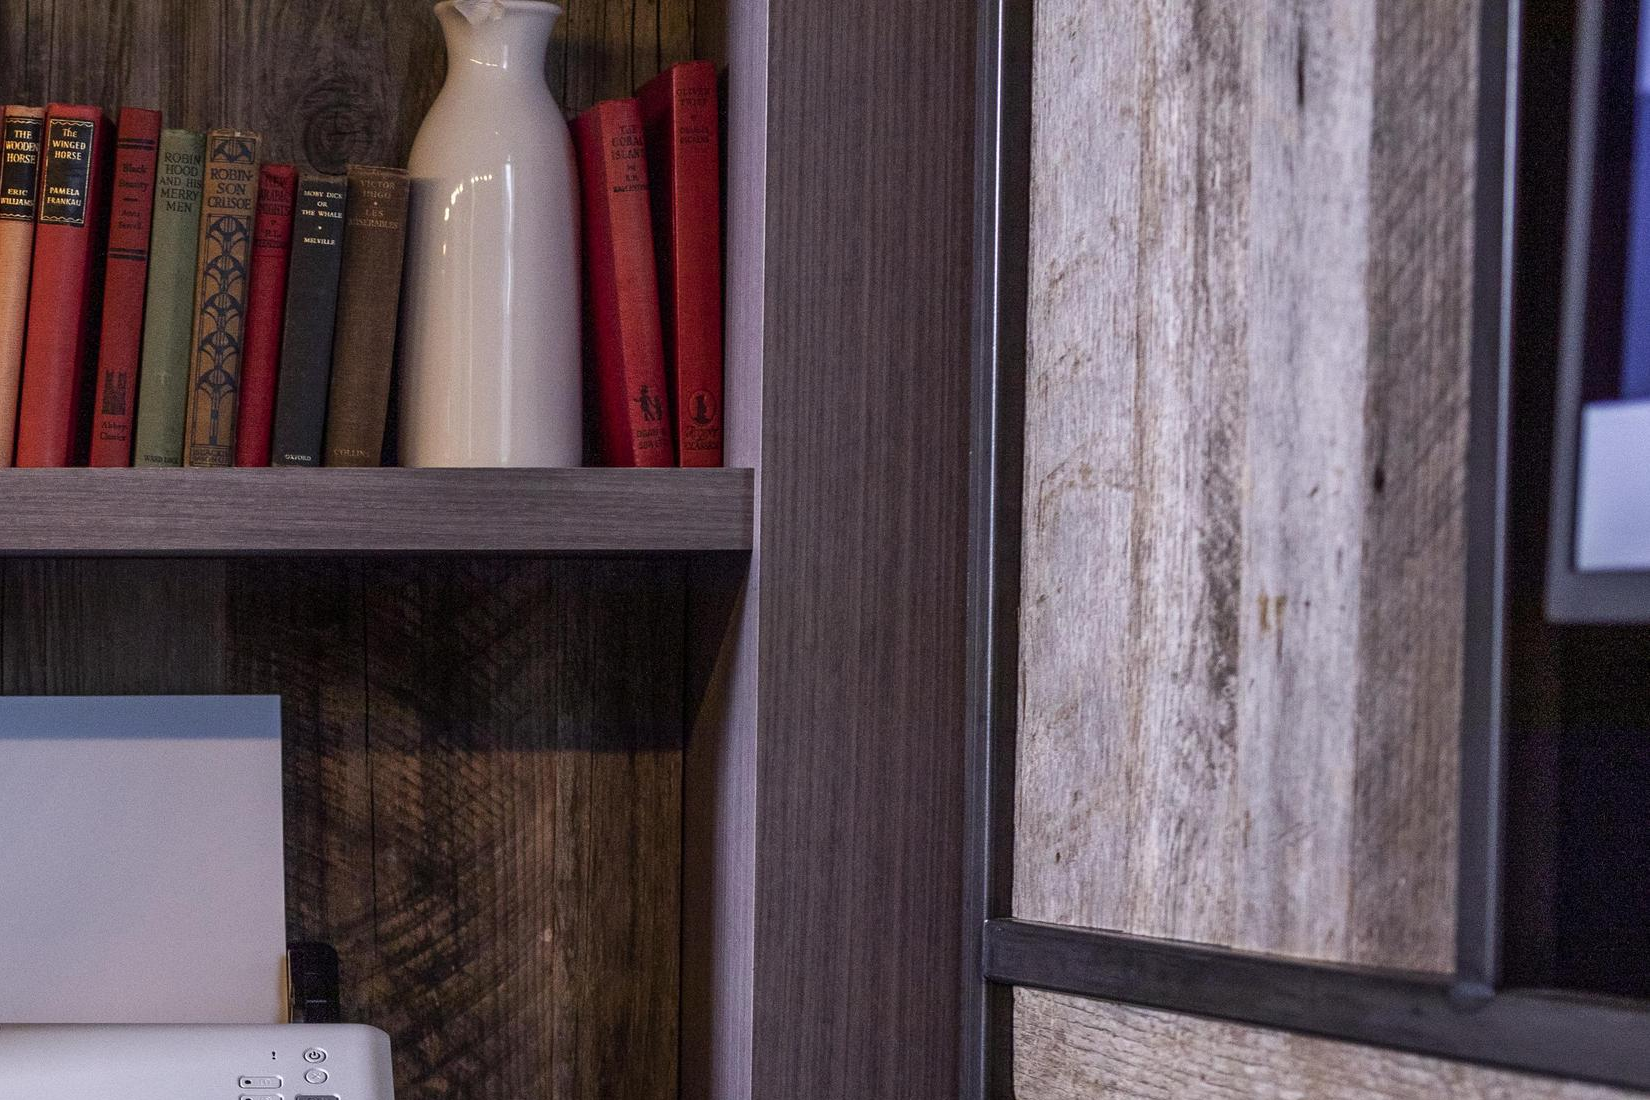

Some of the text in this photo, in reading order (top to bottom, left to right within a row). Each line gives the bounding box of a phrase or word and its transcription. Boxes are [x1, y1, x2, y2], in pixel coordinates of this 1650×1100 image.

[14, 130, 32, 139] THE
[62, 128, 78, 138] The
[5, 141, 40, 151] WOODEN
[52, 139, 86, 150] WINGED
[6, 153, 36, 164] HORSE
[54, 150, 82, 161] HORSE
[164, 152, 200, 164] ROBIN
[165, 164, 198, 177] HOOD
[210, 168, 253, 181] ROBIN-
[160, 177, 201, 189] AND HIS
[361, 180, 395, 190] VICTOR
[8, 188, 28, 197] ERIC
[49, 187, 80, 197] PAMELA
[161, 189, 199, 200] MERRY
[217, 183, 246, 195] SON
[304, 191, 343, 199] MOBY DICK
[166, 201, 192, 213] MEN
[208, 196, 251, 209] CRUSOE
[301, 209, 343, 219] THE WHALE
